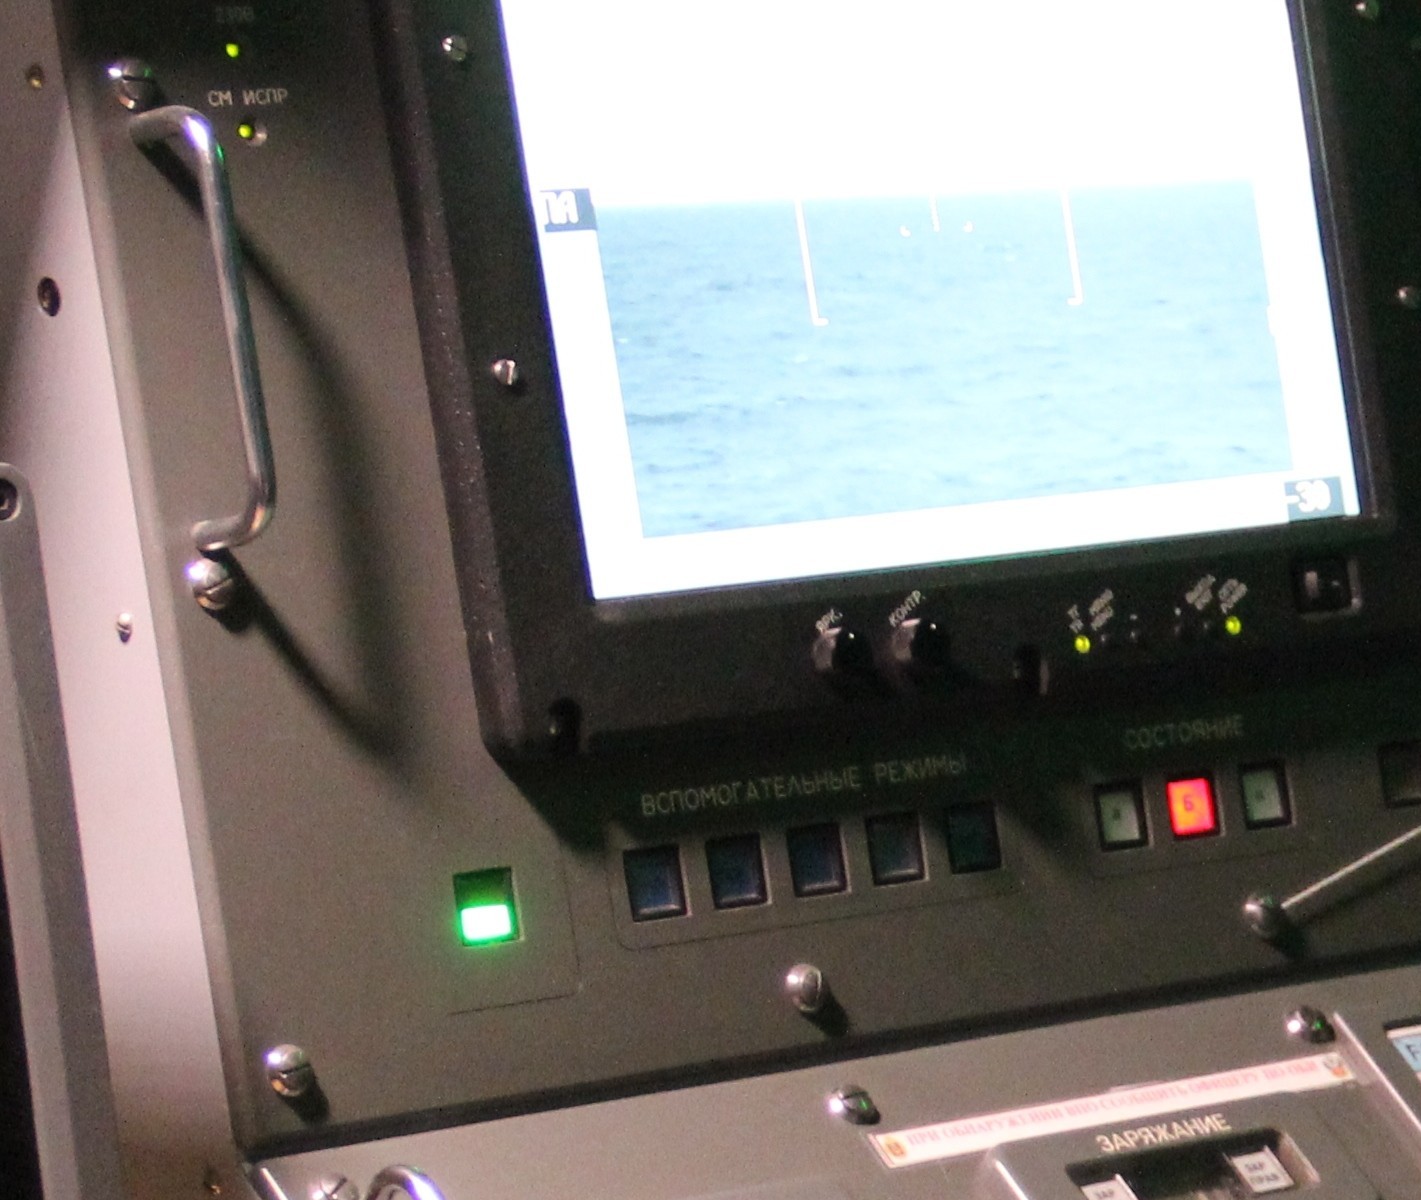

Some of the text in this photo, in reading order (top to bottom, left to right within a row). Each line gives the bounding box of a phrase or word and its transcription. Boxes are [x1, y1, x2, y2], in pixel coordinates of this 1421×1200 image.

[207, 87, 289, 107] СМ ИСПР
[1124, 714, 1243, 750] СОСТОЯНИЕ
[641, 751, 967, 817] ВСПОМОГАТЕЛЬНЫЕ РЕЖИМЫ
[1096, 1113, 1232, 1154] ЗАРЯЖАНИЕ
